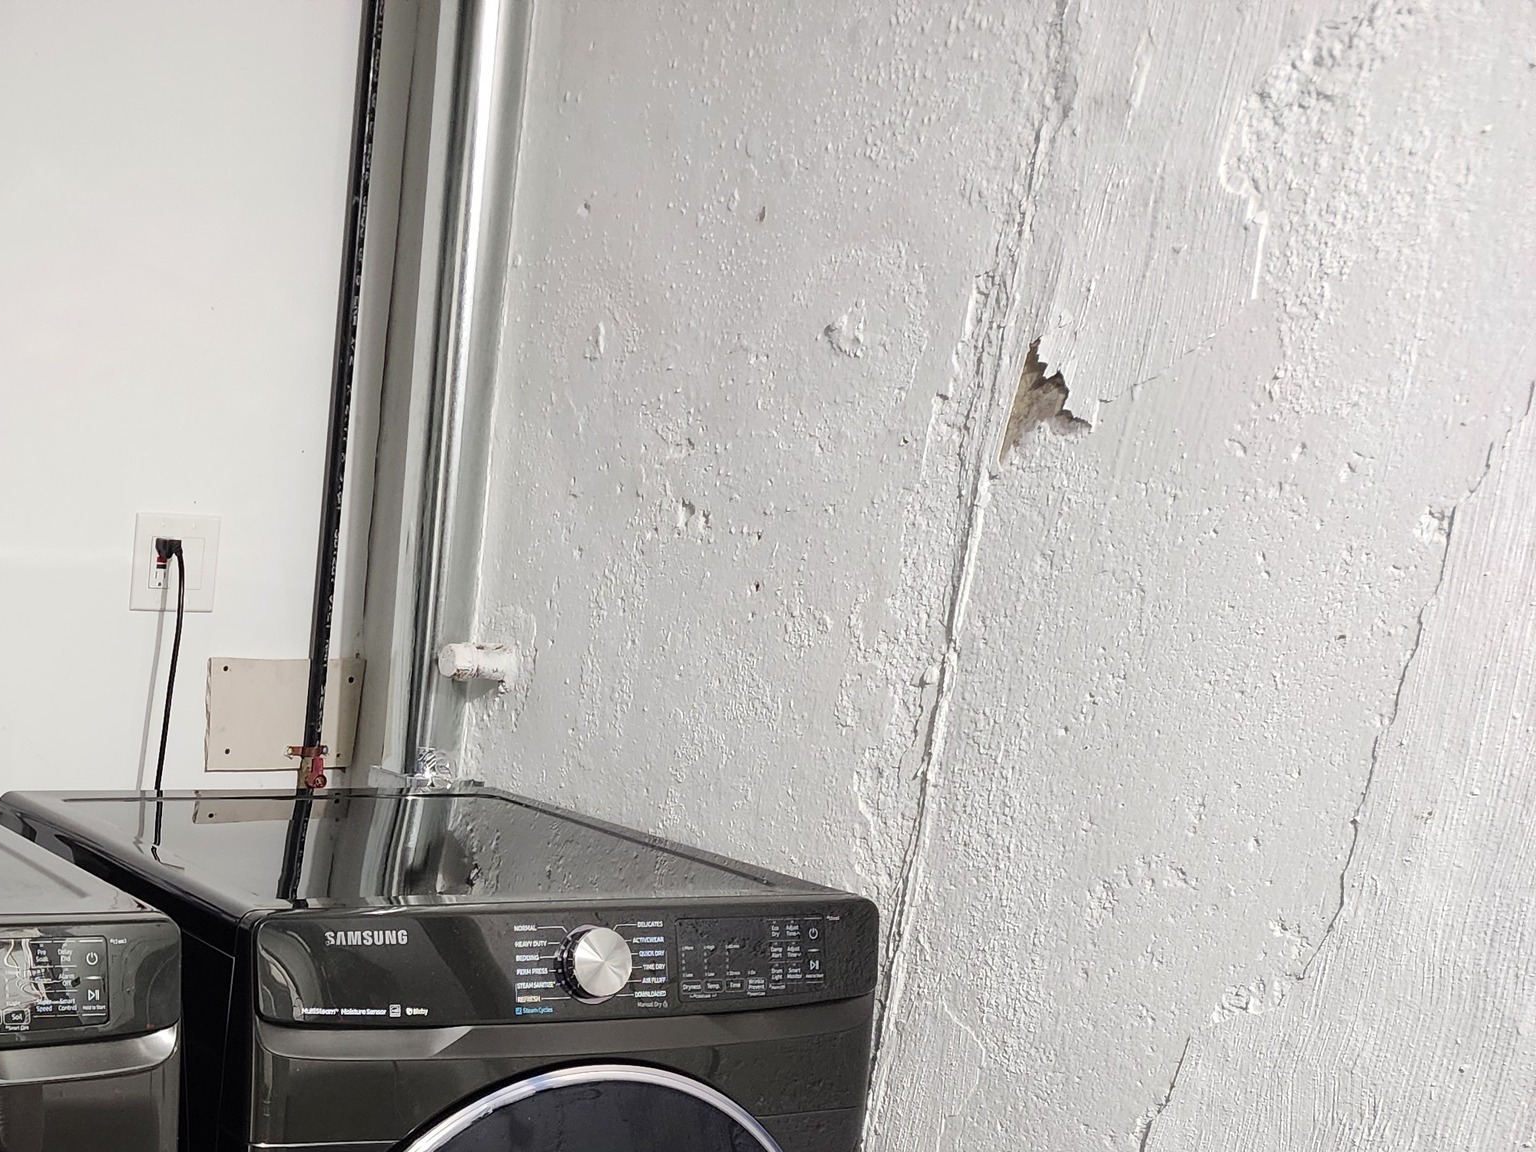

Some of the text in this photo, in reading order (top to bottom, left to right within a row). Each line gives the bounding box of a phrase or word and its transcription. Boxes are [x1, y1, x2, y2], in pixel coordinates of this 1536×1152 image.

[514, 924, 538, 932] NORMAL
[636, 920, 663, 928] DELICATES
[324, 929, 408, 946] SAMSUNG
[632, 936, 664, 944] ACTIVEWEAR
[514, 940, 532, 948] HEAVY
[515, 954, 540, 962] BEDDING
[516, 967, 549, 976] PERM PRESS
[634, 990, 667, 998] DOWNLOADED
[36, 1005, 53, 1013] Speed
[11, 1013, 23, 1021] Soil
